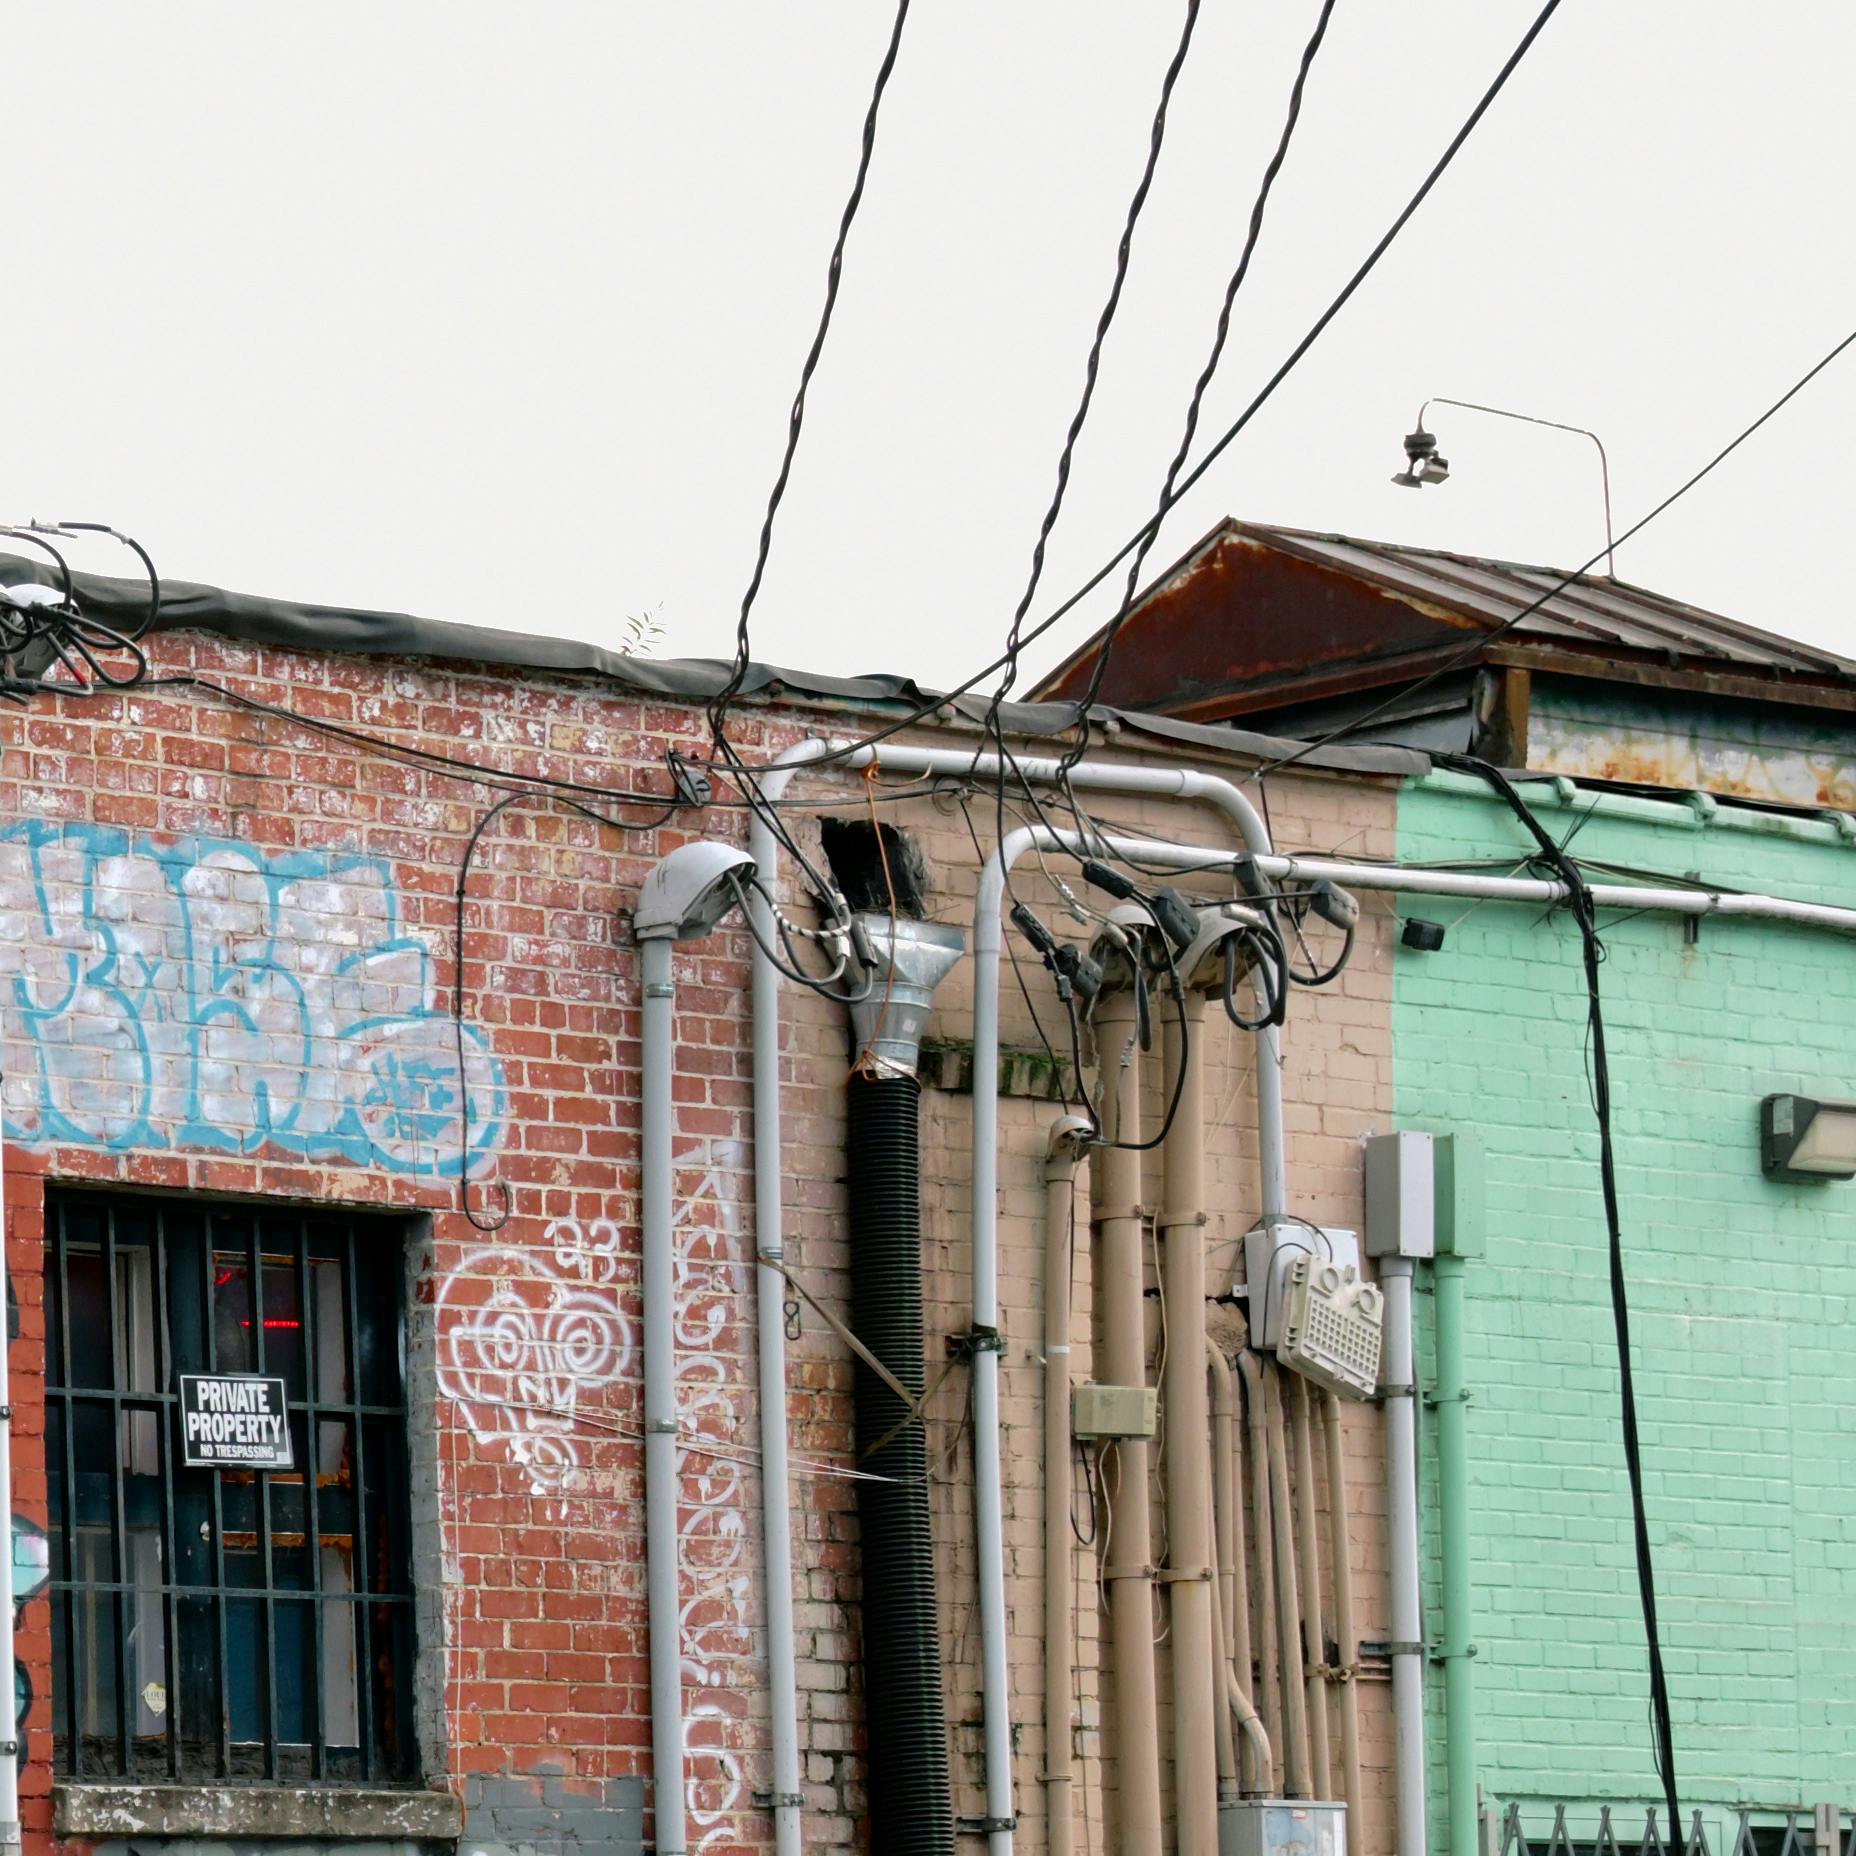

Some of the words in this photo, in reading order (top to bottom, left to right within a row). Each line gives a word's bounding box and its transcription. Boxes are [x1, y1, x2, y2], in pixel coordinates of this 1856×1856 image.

[196, 1381, 270, 1413] PRIVATE
[188, 1412, 281, 1443] PROPERTY
[200, 1444, 213, 1457] NO
[215, 1445, 274, 1458] TRESPASSING
